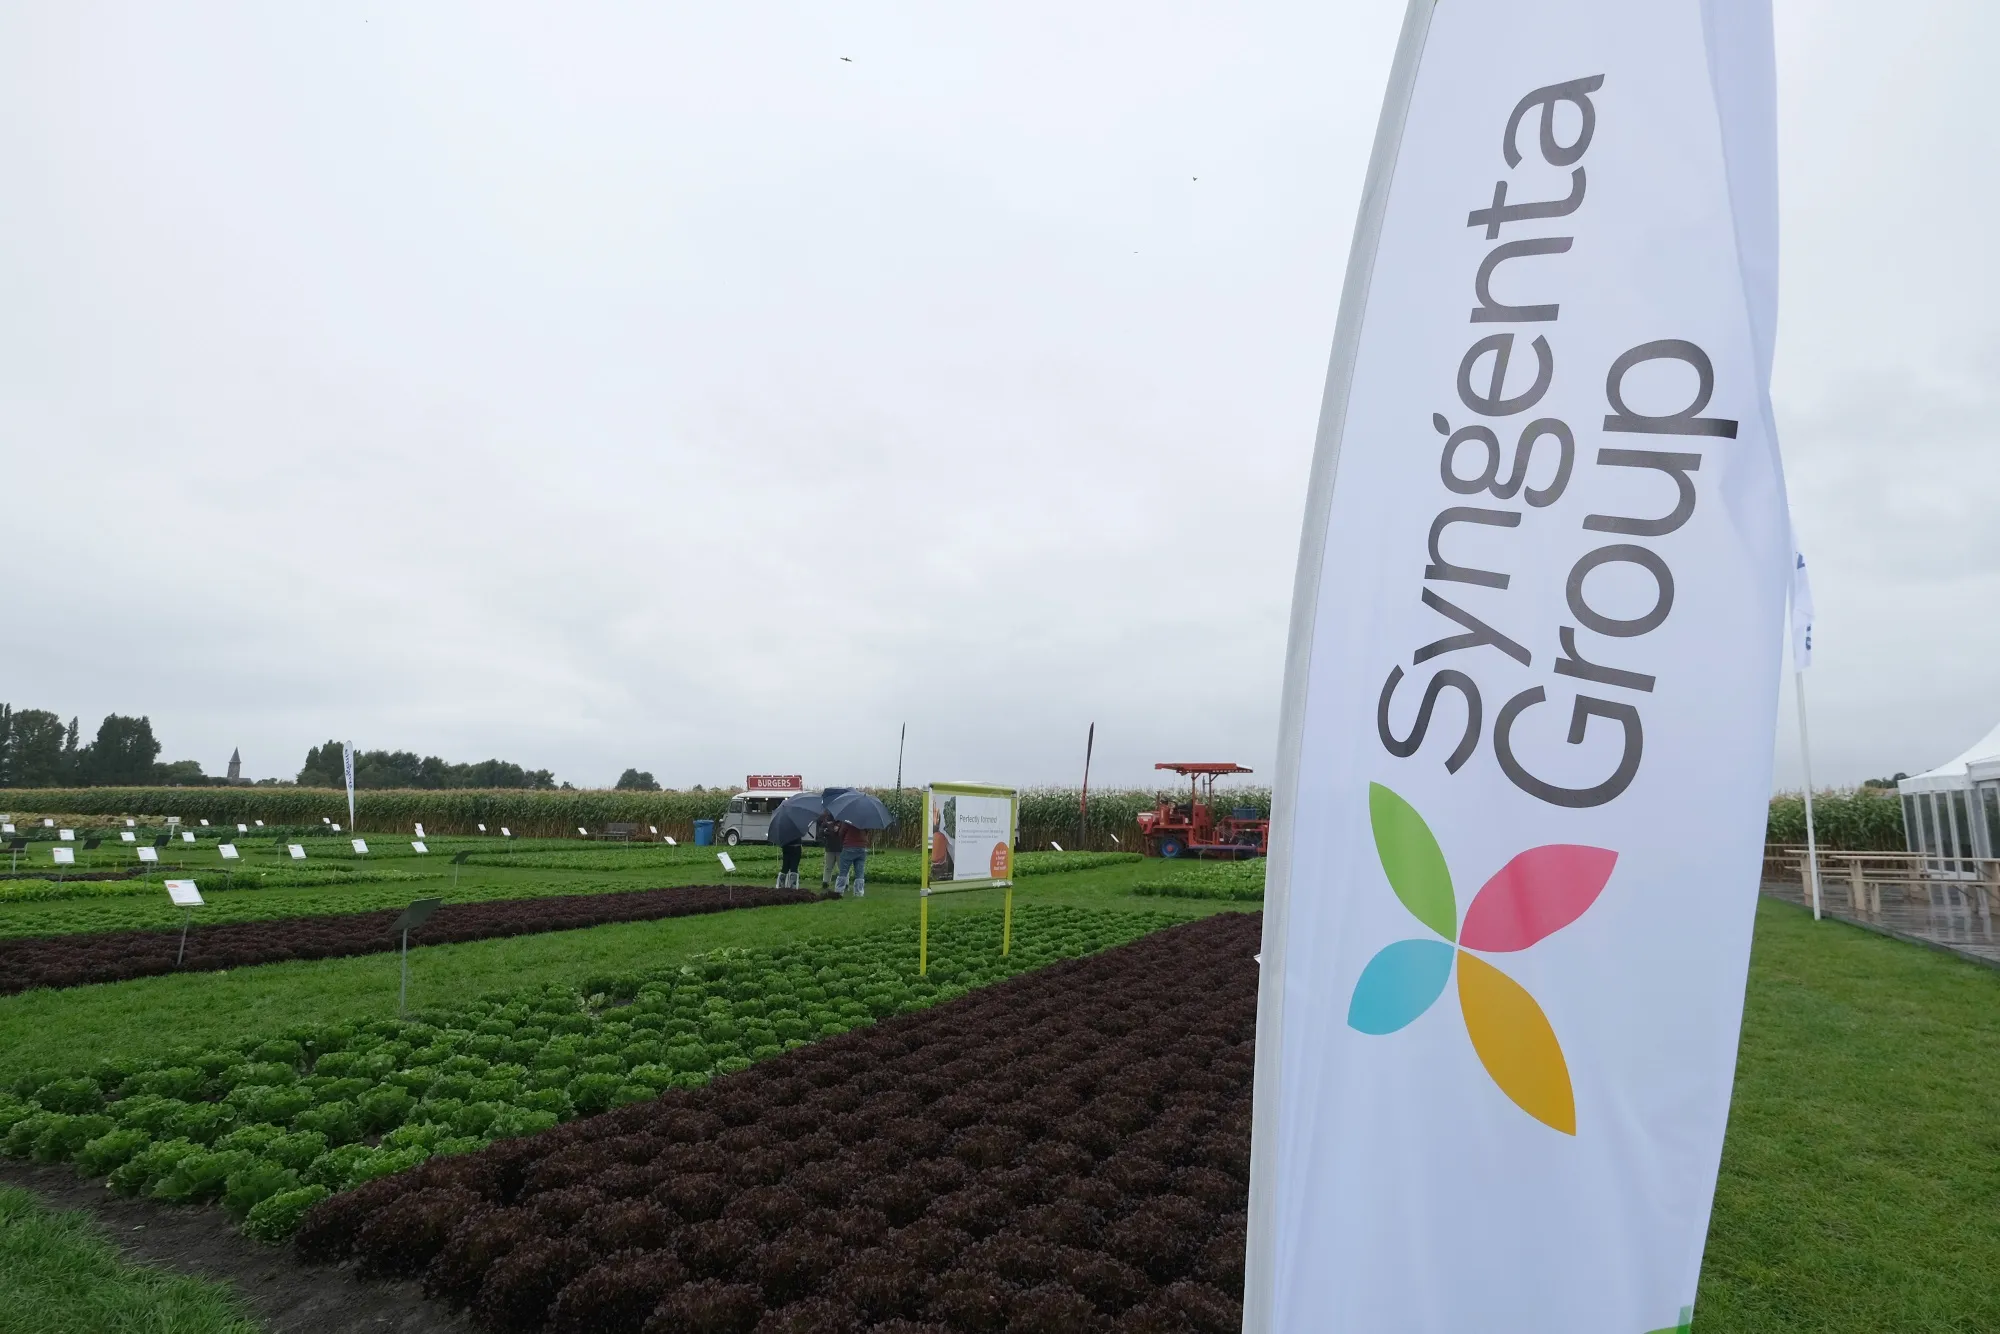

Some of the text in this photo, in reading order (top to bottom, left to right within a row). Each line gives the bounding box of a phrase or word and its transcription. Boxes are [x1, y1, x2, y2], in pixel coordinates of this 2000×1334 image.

[1377, 73, 1605, 775] Syngenta
[1493, 339, 1739, 808] Group
[757, 779, 791, 787] BURGERS
[960, 814, 980, 824] Perfectly
